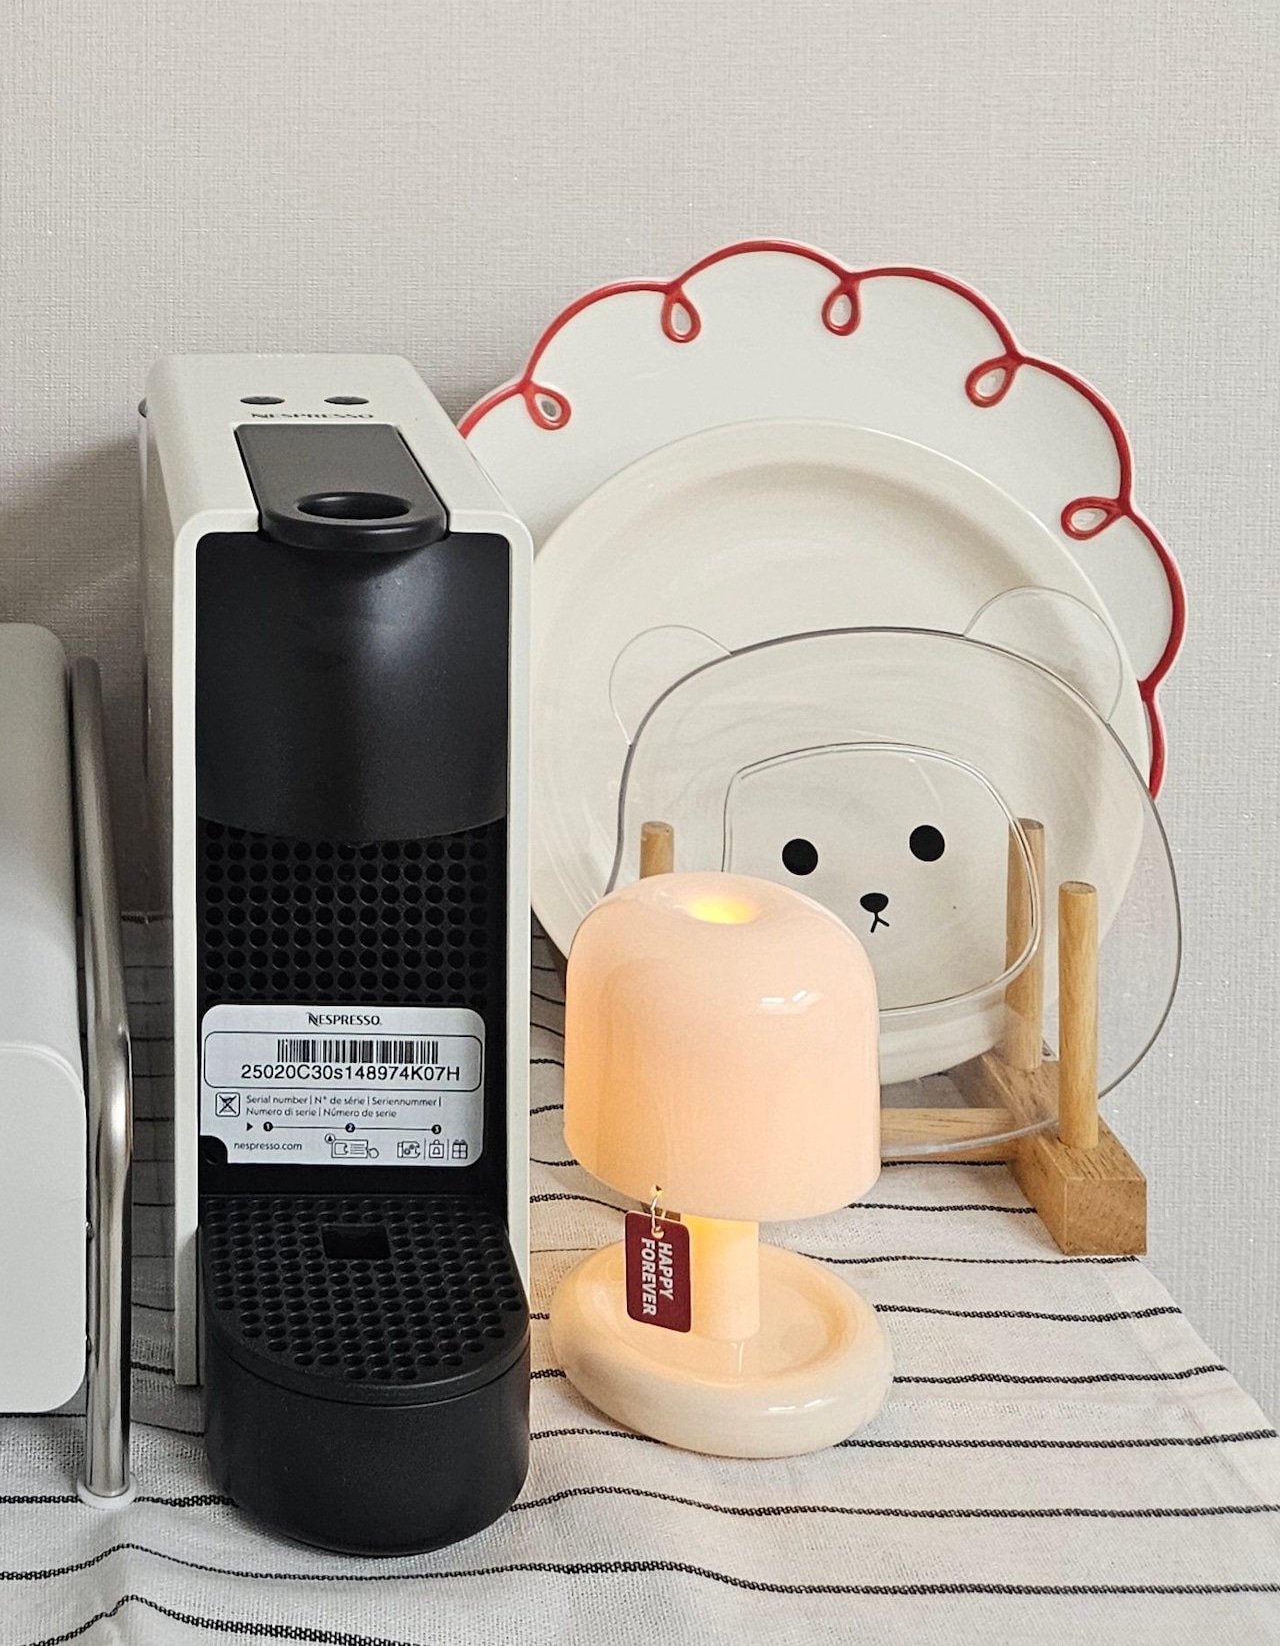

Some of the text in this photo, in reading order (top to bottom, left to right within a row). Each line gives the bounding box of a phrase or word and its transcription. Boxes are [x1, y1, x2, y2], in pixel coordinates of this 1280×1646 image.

[240, 1064, 460, 1082] 25020C30s148974K07H
[246, 1095, 271, 1104] Serial
[273, 1095, 307, 1104] number
[330, 1096, 343, 1104] de
[344, 1096, 365, 1105] série
[371, 1096, 437, 1106] Seriennummer
[246, 1107, 282, 1116] Numero
[284, 1107, 293, 1116] di
[295, 1107, 317, 1117] serie
[323, 1107, 360, 1117] Número
[361, 1108, 374, 1117] de
[375, 1108, 397, 1118] serie
[233, 1142, 302, 1151] nespresso.com
[641, 1237, 657, 1316] FOREVER
[658, 1241, 674, 1301] HAPPY
